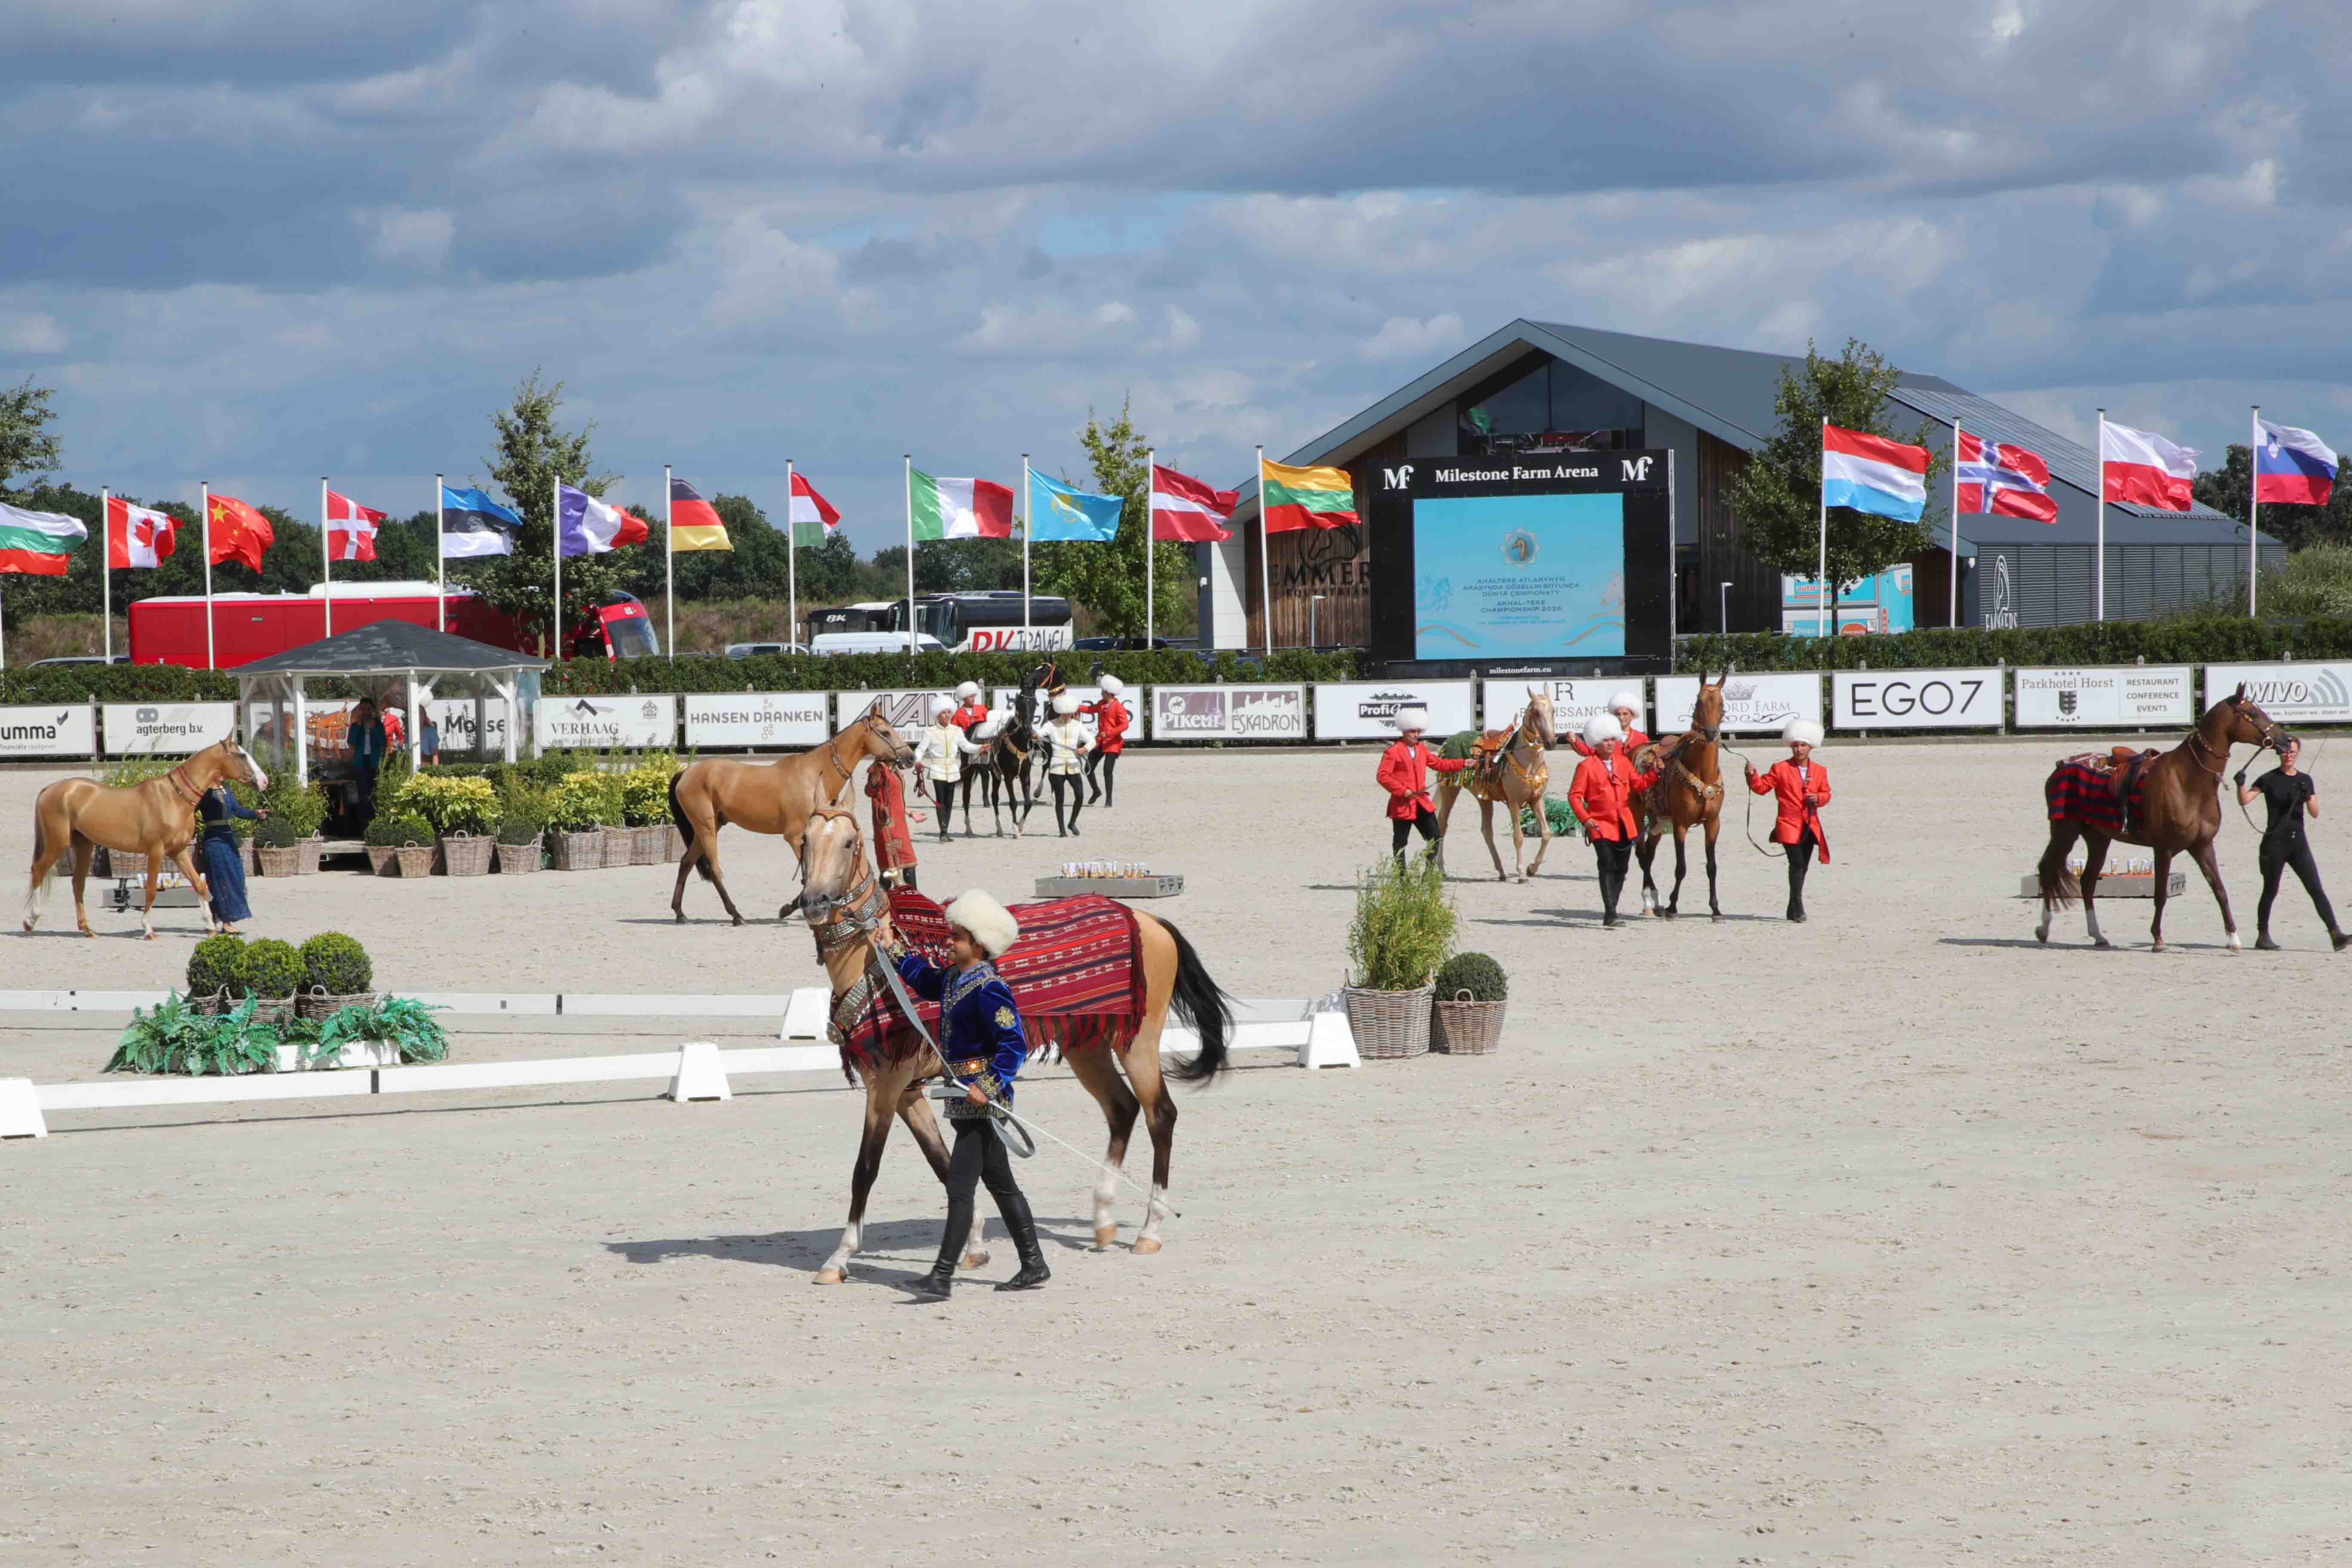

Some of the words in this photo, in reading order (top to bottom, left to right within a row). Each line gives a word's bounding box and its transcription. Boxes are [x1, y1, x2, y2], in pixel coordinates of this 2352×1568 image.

[1435, 468, 1509, 483] Milestone
[1513, 466, 1553, 480] Farm
[1554, 466, 1599, 479] Arena
[826, 614, 846, 623] BK
[1489, 666, 1551, 675] milestonefarm.eu
[2021, 677, 2077, 689] Parkhotel
[2081, 677, 2114, 688] Horst
[2126, 678, 2179, 686] RESTAURANT
[1851, 680, 1984, 716] EGO7
[2245, 680, 2308, 703] WIVO
[1755, 700, 1792, 712] FARM
[690, 711, 749, 724] HANSEN
[753, 710, 823, 723] DRANKEN
[1160, 712, 1224, 729] Pikeur
[136, 723, 186, 736] agterberg
[189, 722, 204, 733] b.v.
[551, 722, 619, 735] VERHAAG
[1232, 714, 1300, 735] ESKADRON
